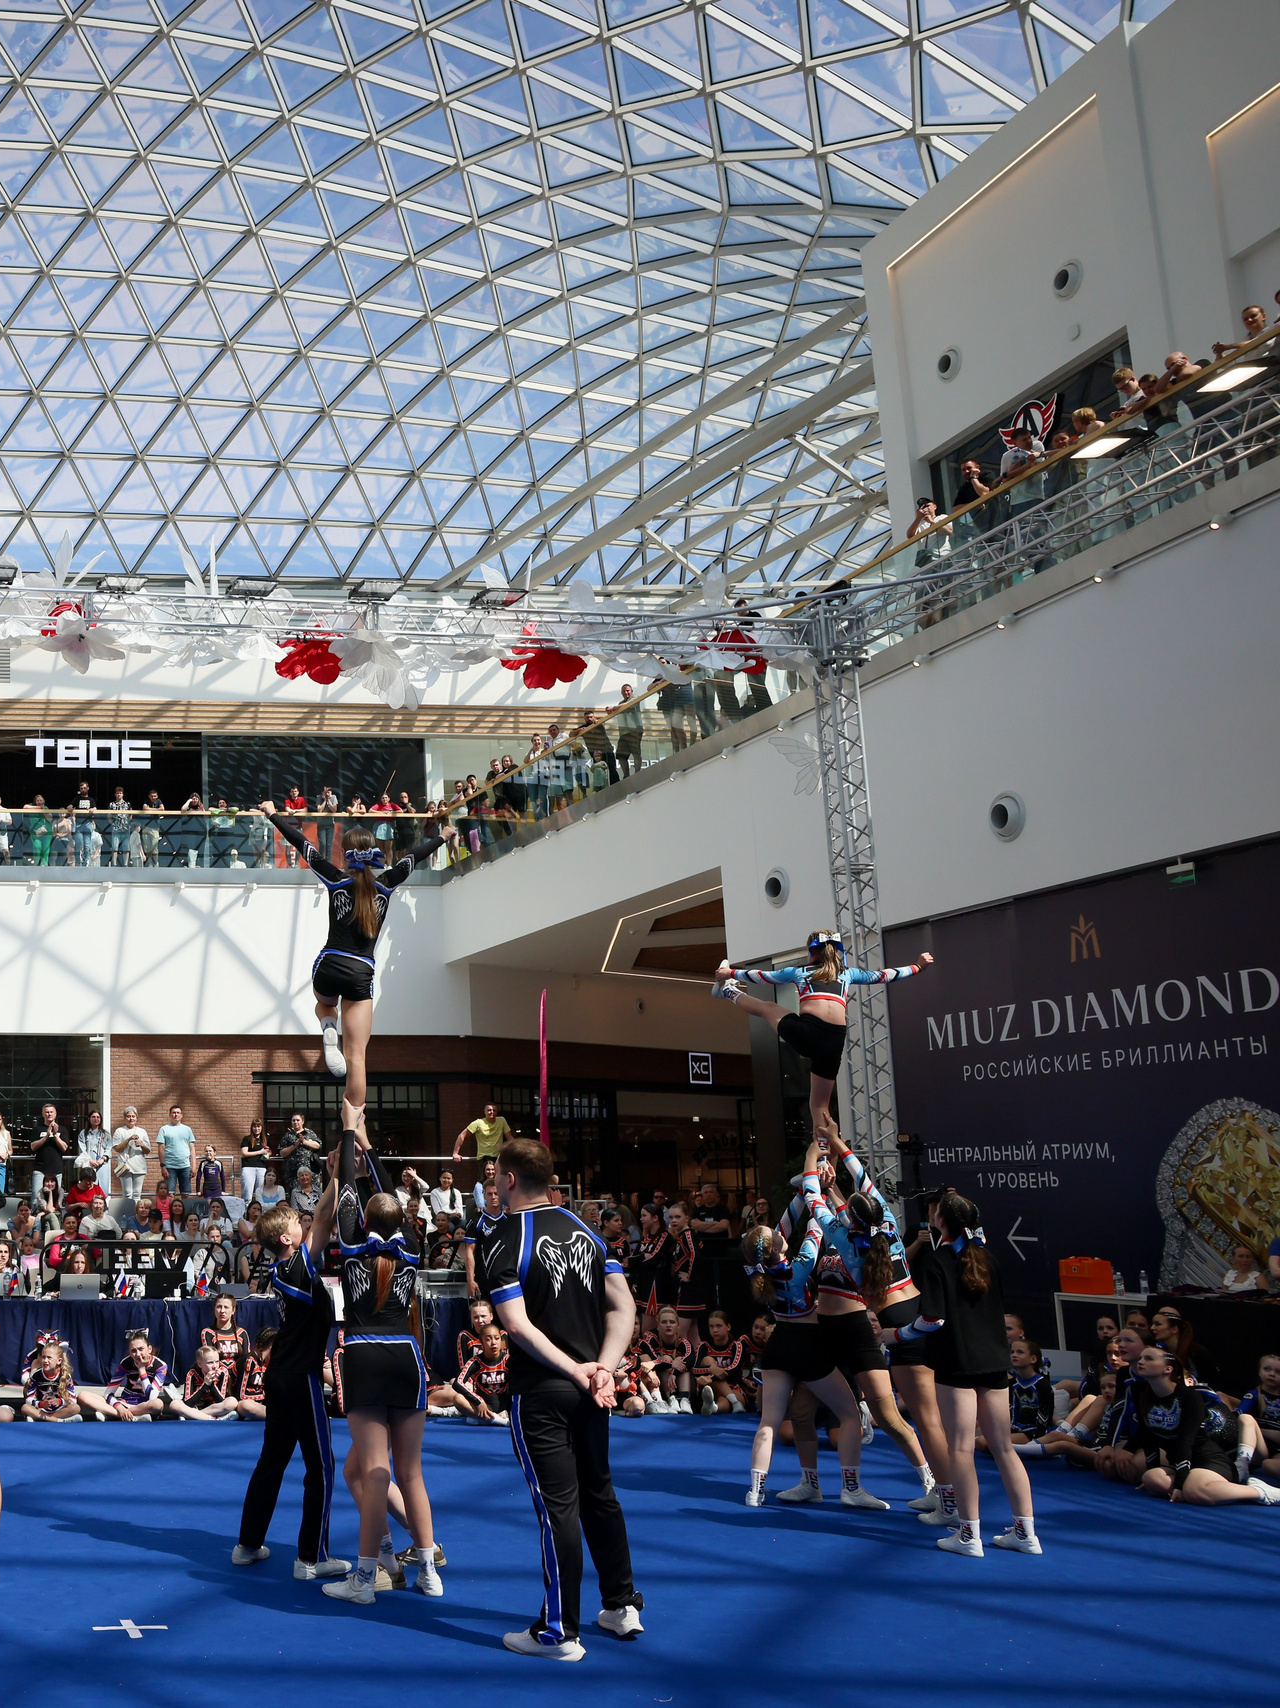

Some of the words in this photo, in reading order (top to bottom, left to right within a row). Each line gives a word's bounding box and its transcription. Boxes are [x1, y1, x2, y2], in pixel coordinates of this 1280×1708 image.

[25, 738, 151, 769] ТВОЕ
[926, 1004, 1020, 1052] MIUZ
[1033, 967, 1280, 1038] DIAMOND
[962, 1051, 1092, 1082] РОССИЙСКИЕ
[1101, 1034, 1268, 1069] БРИЛЛИАНТЫ
[928, 1140, 1037, 1164] ЦЕНТРАЛЬНЫЙ
[1041, 1141, 1116, 1164] АТРИУМ,
[976, 1172, 984, 1188] 1
[987, 1170, 1060, 1189] УРОВЕНЬ
